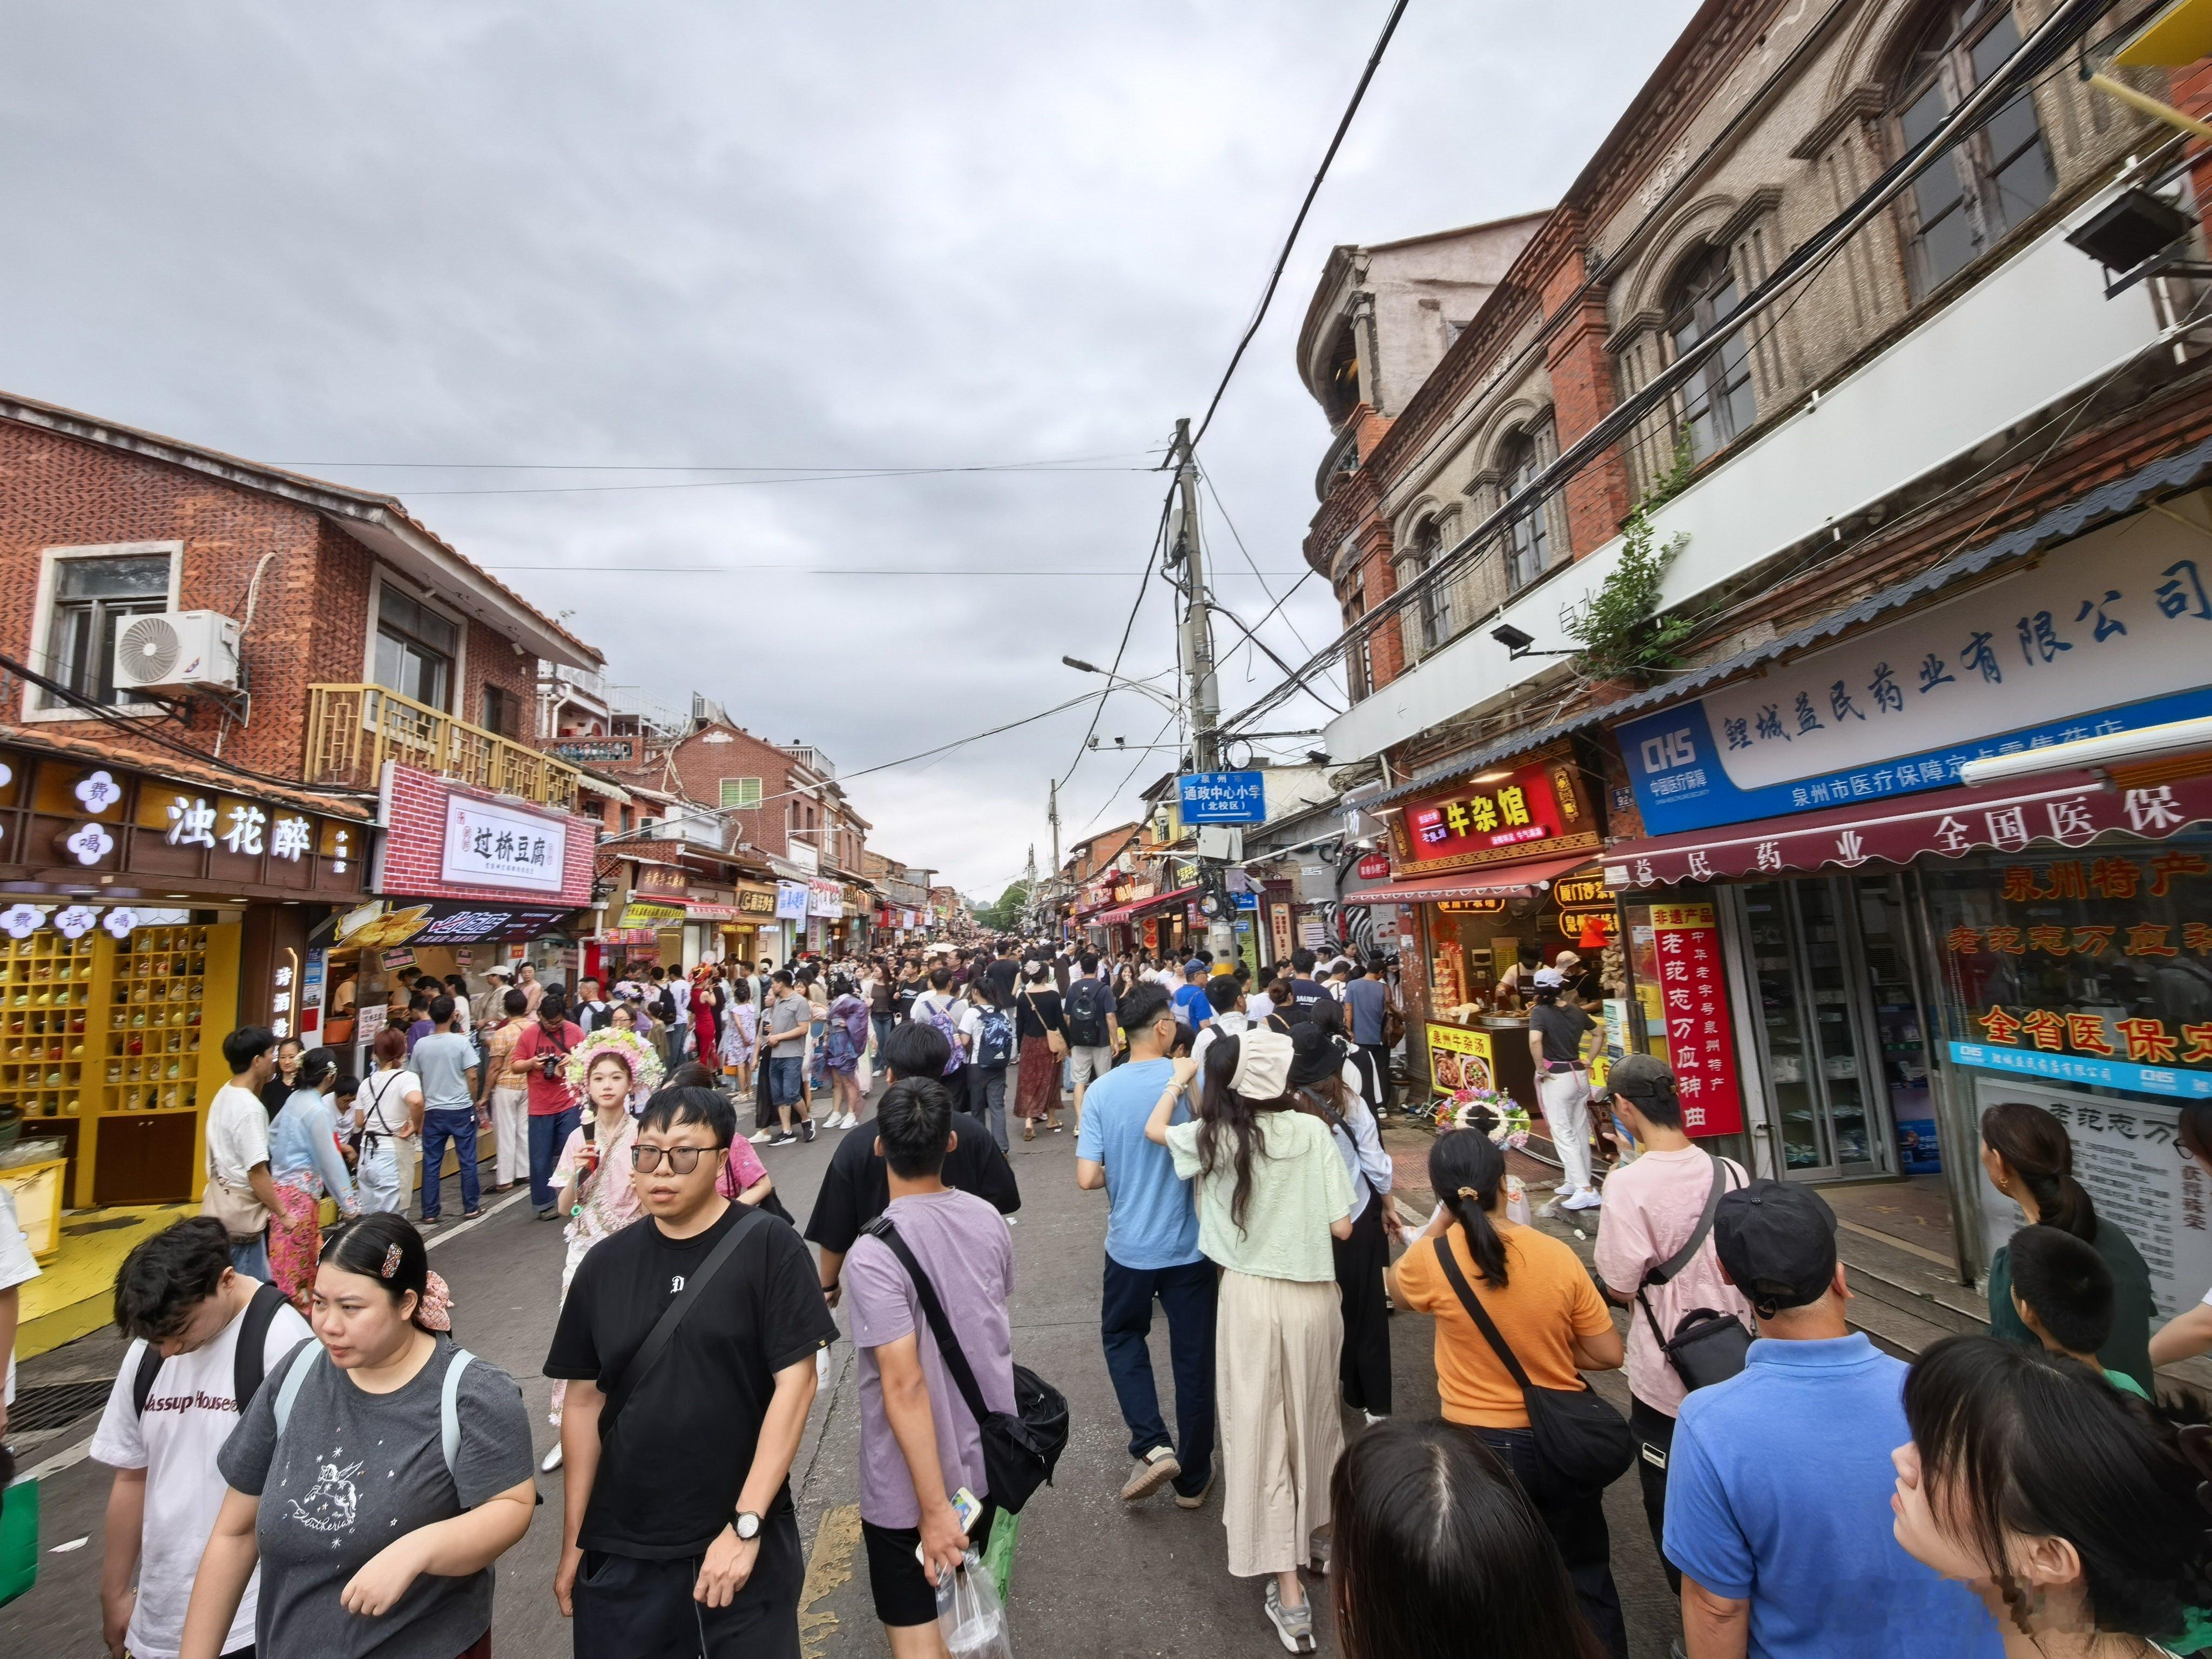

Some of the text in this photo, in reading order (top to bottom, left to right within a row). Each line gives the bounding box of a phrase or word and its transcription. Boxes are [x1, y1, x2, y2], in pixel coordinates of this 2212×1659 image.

[1724, 559, 2211, 752] 鲤城益民药业有限公司
[1183, 785, 1261, 801] 通政中心小学
[1447, 785, 1529, 837] 牛杂馆
[1934, 784, 2186, 854] 全国医保
[166, 797, 311, 862] 浊花醉
[333, 830, 349, 874] 小酒馆
[474, 827, 545, 867] 过桥豆腐
[2001, 850, 2210, 901] 泉州特产
[1654, 907, 1715, 925] 非遗产品
[271, 966, 293, 1062] 诗酒趁
[1661, 932, 1706, 1128] 老范志万应神曲
[1690, 930, 1725, 1091] 中华老字号泉州特产
[1433, 1029, 1485, 1054] 泉州牛杂汤
